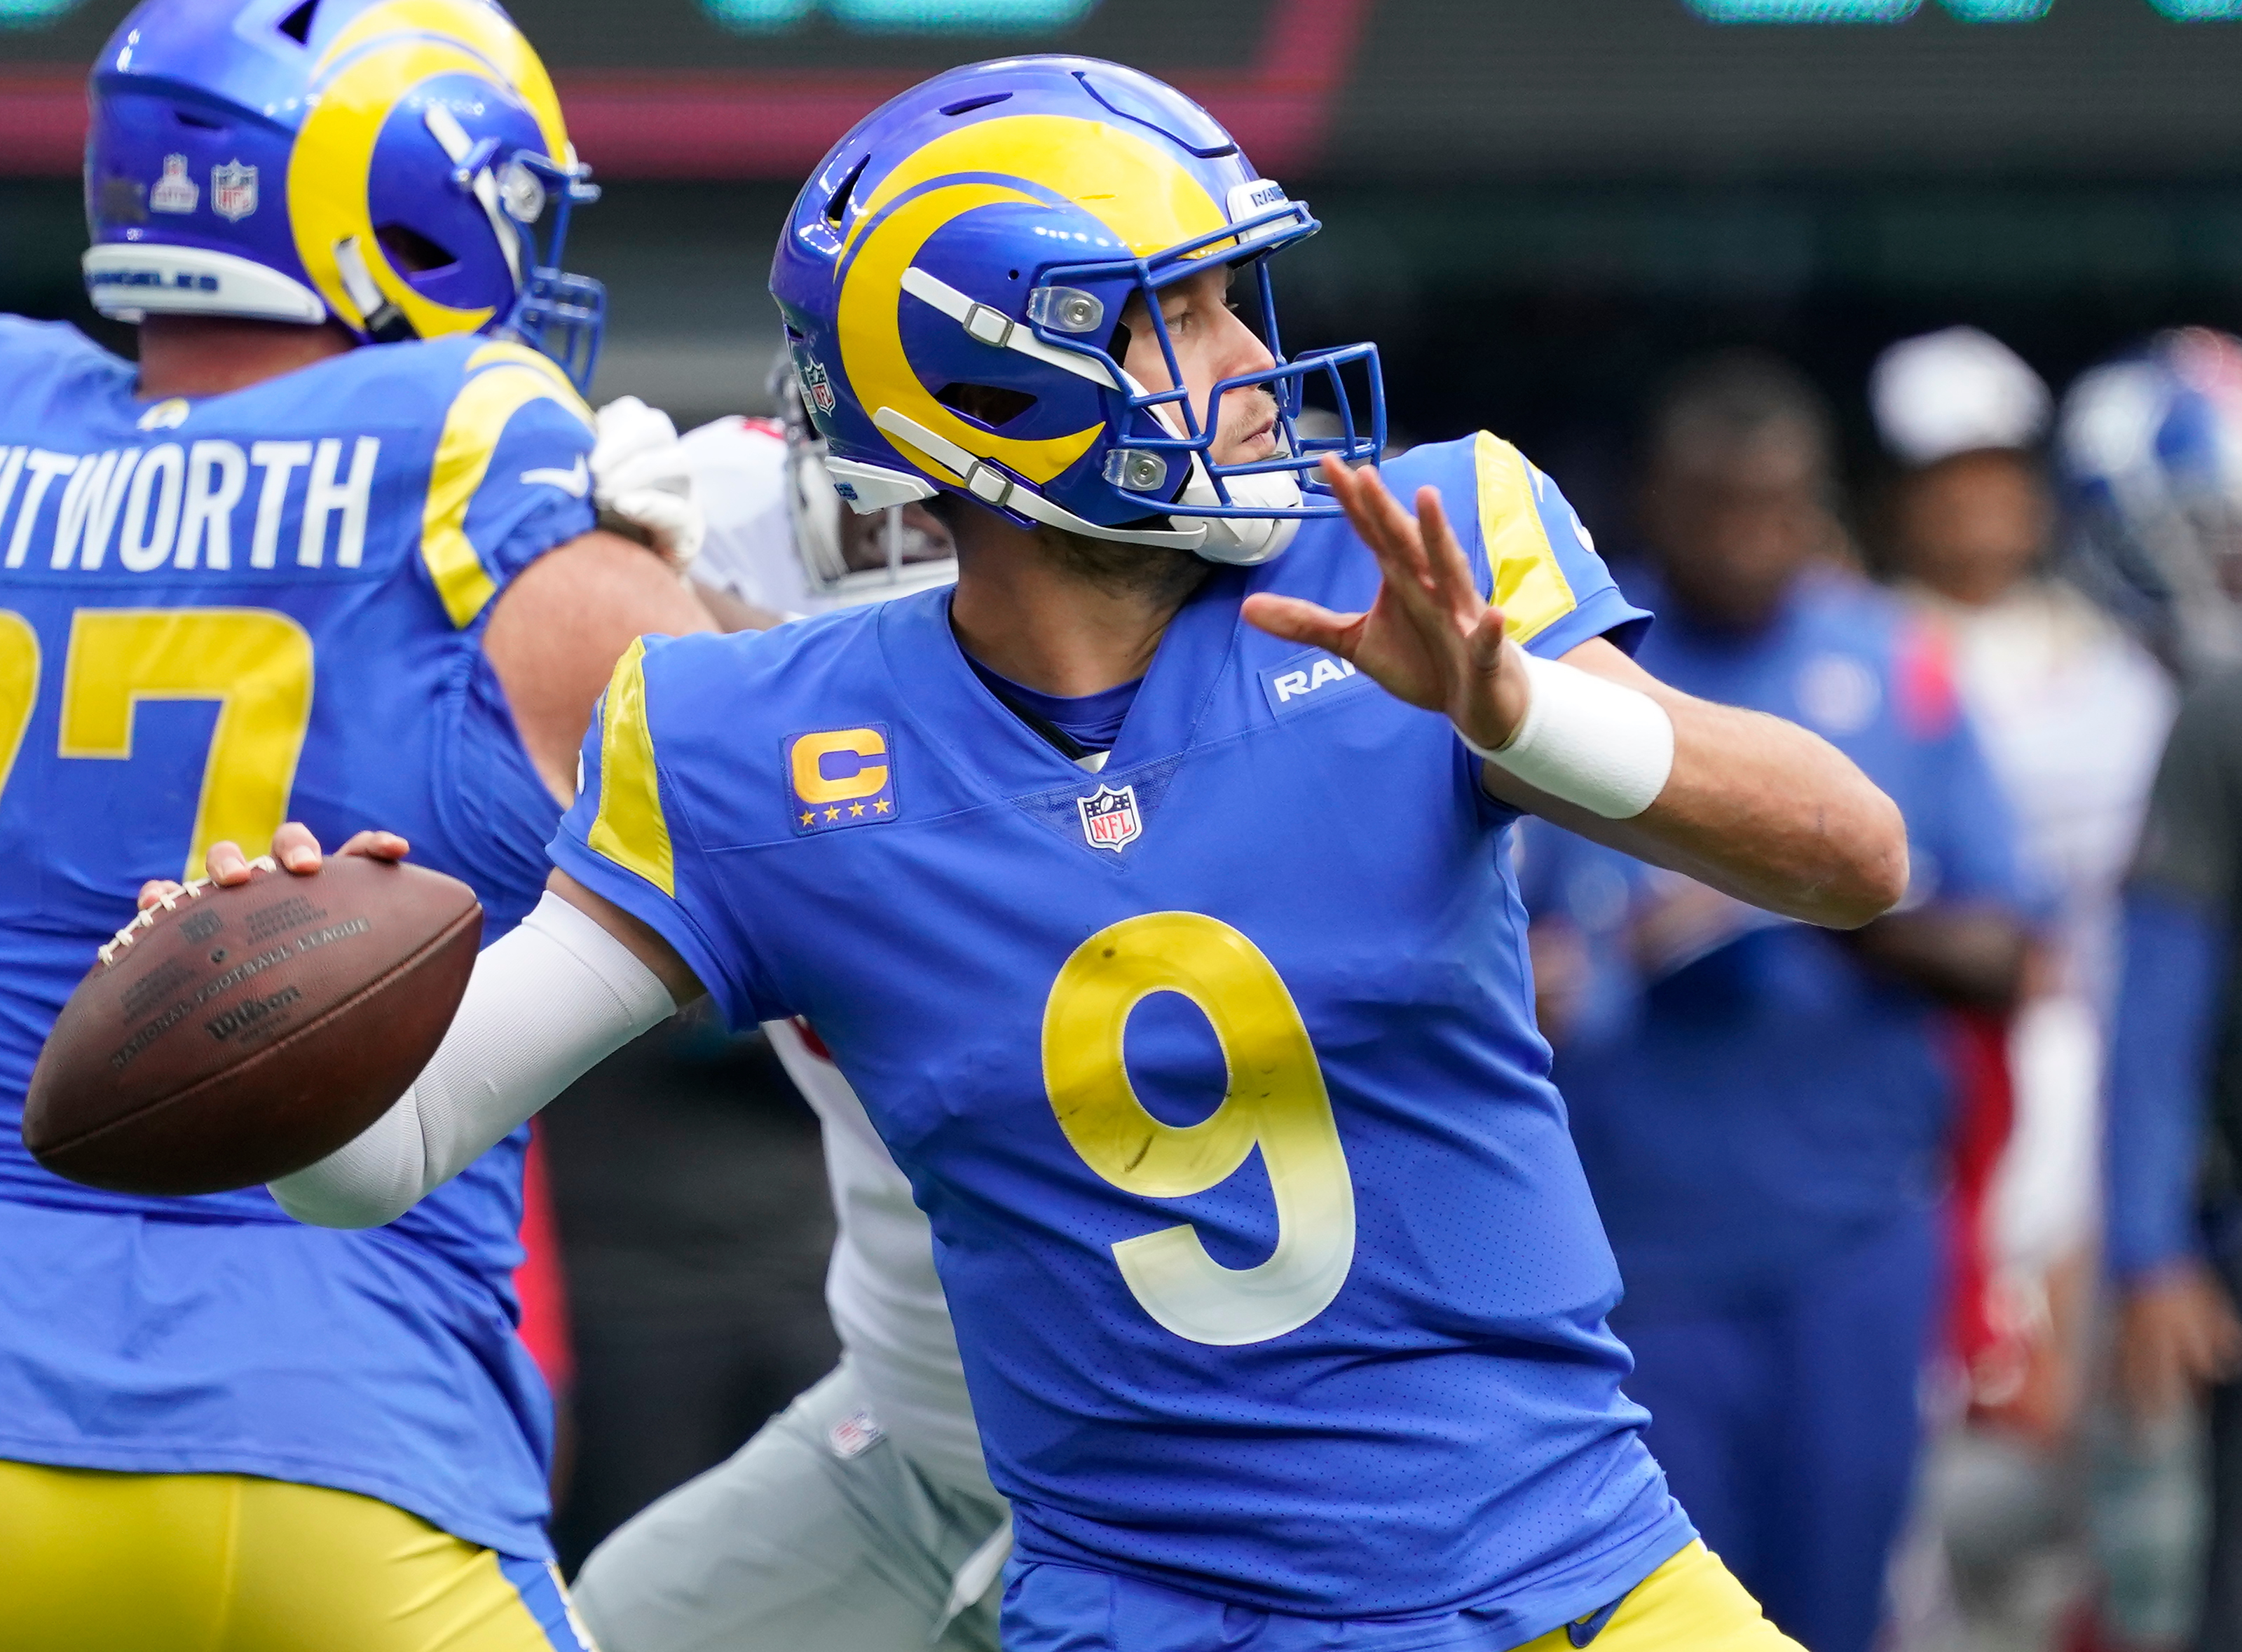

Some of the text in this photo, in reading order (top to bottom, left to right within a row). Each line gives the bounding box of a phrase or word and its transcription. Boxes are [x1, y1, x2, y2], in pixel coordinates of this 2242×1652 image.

[813, 385, 834, 407] NFL
[0, 435, 381, 572] ITWORTH
[1273, 657, 1356, 702] RA
[791, 728, 889, 805] C
[1091, 812, 1132, 839] NFL
[195, 945, 293, 1007] FOOTBALL
[295, 916, 370, 953] LEAGUE
[1041, 910, 1355, 1346] 9
